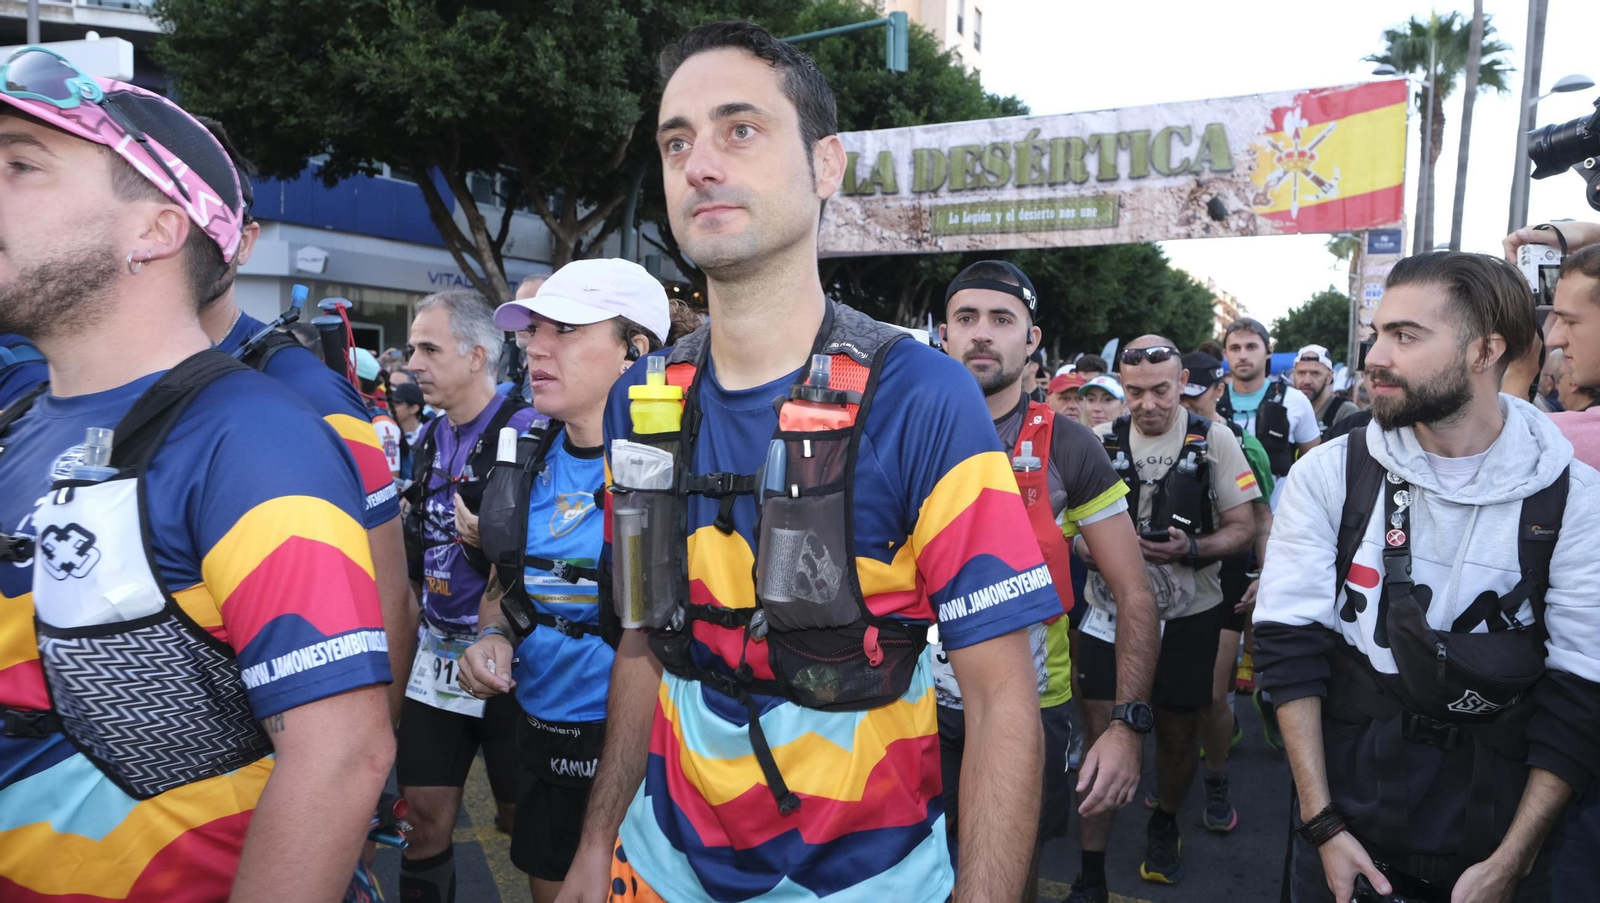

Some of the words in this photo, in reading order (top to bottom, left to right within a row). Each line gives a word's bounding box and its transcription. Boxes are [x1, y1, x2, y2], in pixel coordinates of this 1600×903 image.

[842, 150, 898, 196] LA
[911, 122, 1235, 194] DESÉRTICA
[948, 212, 959, 224] La
[962, 210, 992, 225] Legión
[996, 212, 1002, 224] y
[1006, 208, 1015, 222] el
[1018, 208, 1055, 221] desierto
[1059, 209, 1076, 219] nos
[1080, 207, 1098, 218] une
[425, 576, 452, 596] TRAIL
[433, 657, 460, 685] 91
